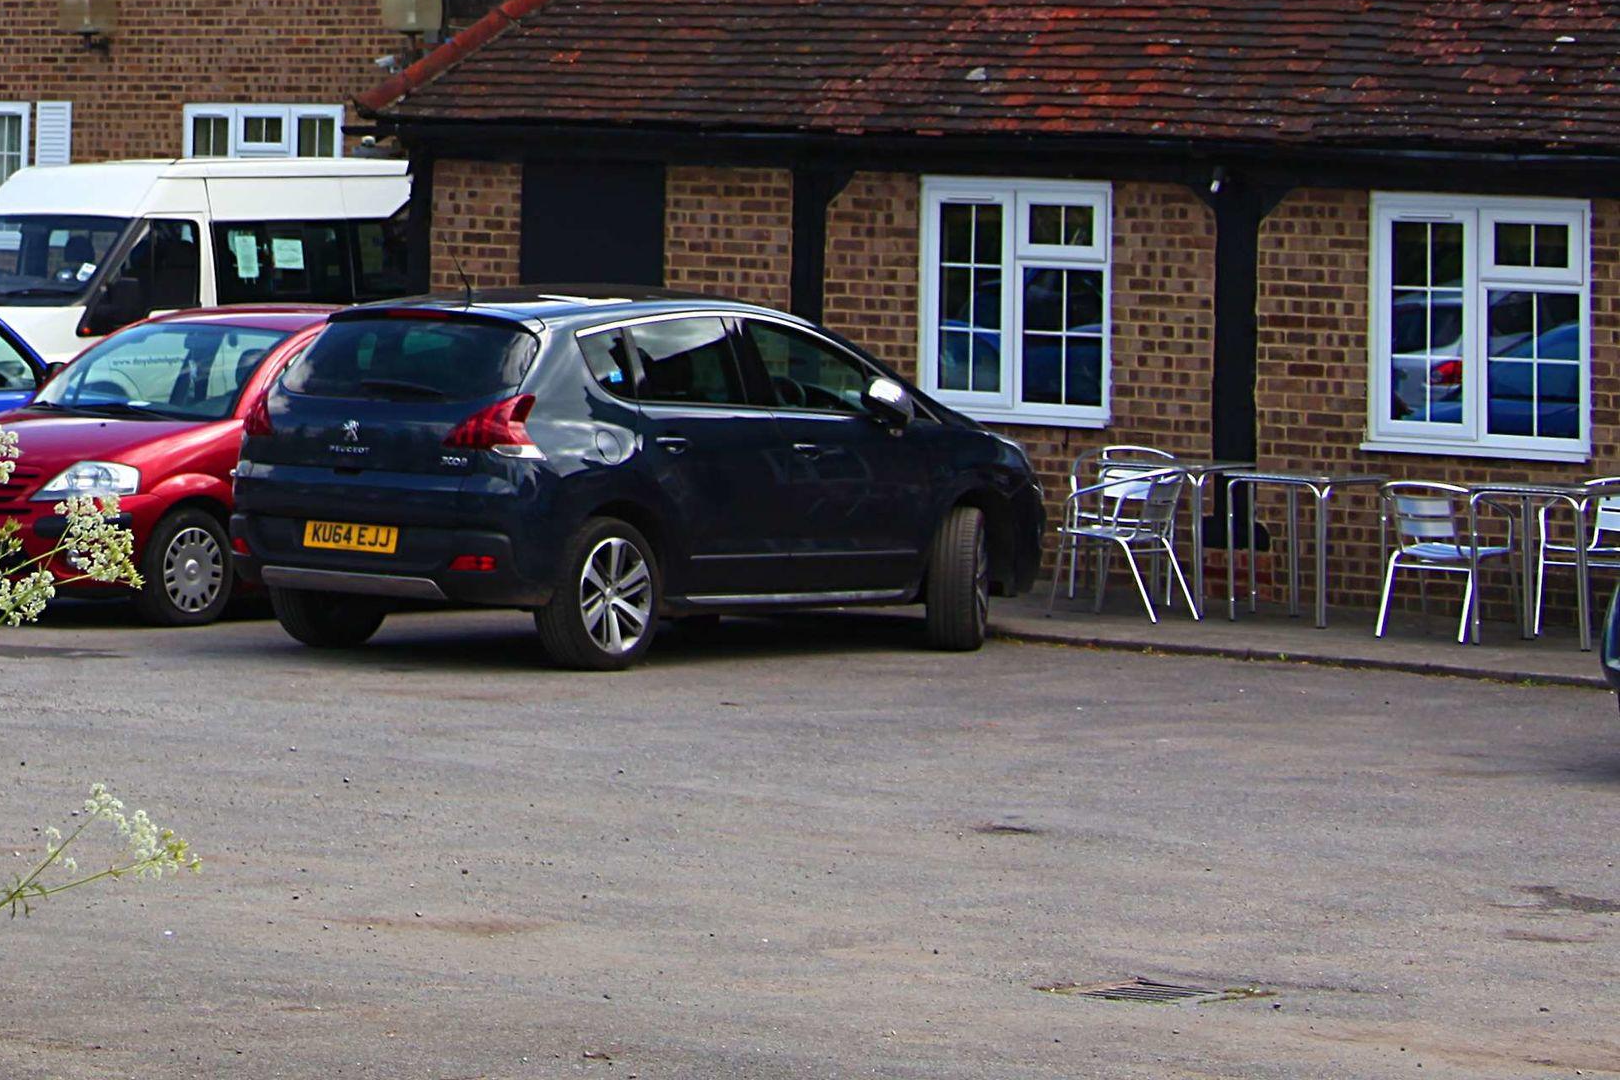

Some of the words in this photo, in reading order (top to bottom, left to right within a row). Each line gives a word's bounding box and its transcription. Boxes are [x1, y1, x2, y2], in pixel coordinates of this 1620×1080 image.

[329, 444, 370, 454] PEUGEOT
[311, 523, 353, 544] KU64
[357, 526, 392, 548] EJJ
